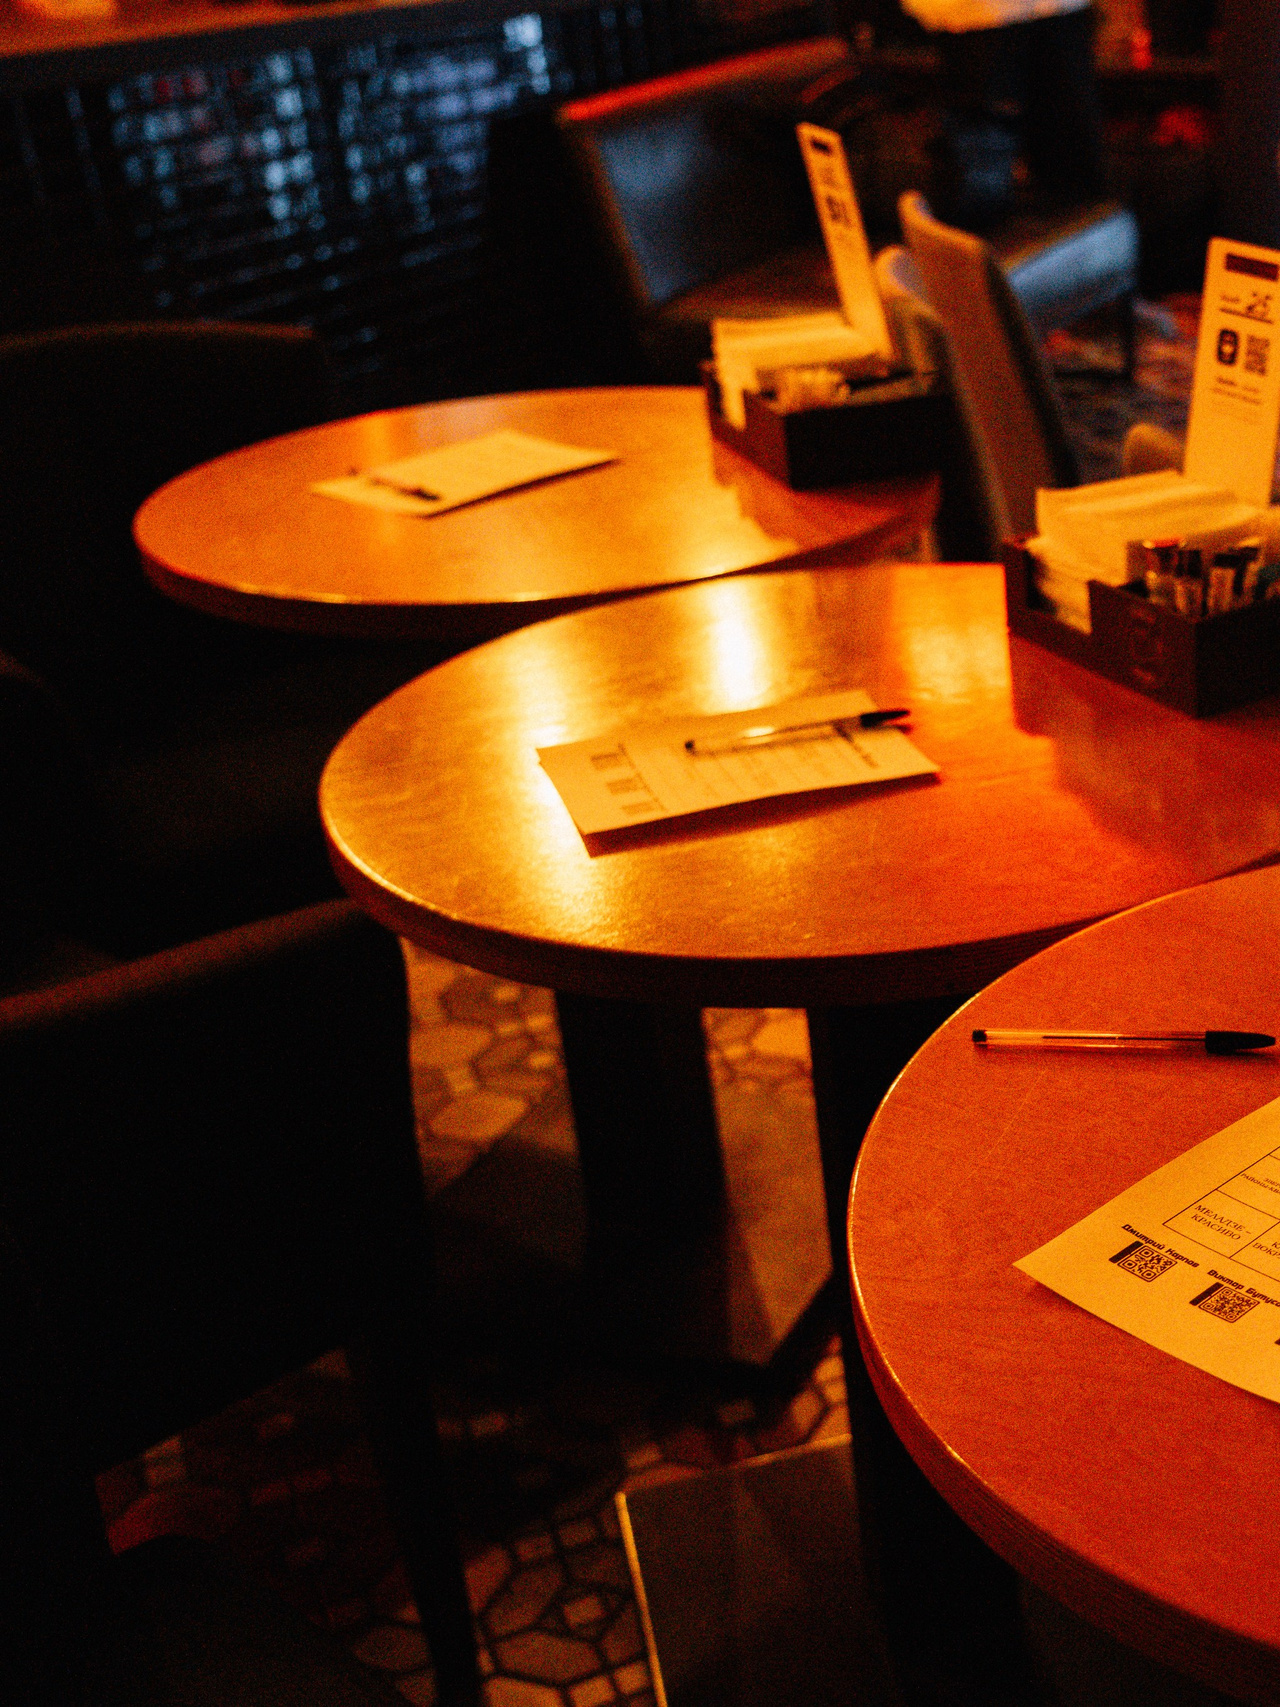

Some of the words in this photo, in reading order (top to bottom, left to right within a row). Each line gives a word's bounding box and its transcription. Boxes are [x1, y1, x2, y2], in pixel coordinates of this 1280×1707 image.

[1191, 1213, 1242, 1241] КРАСИВО
[1194, 1204, 1246, 1232] МЕЛАДЗЕ
[1121, 1223, 1165, 1250] Дмитрий
[1165, 1247, 1200, 1268] Карпов
[1207, 1269, 1245, 1290] Виктор
